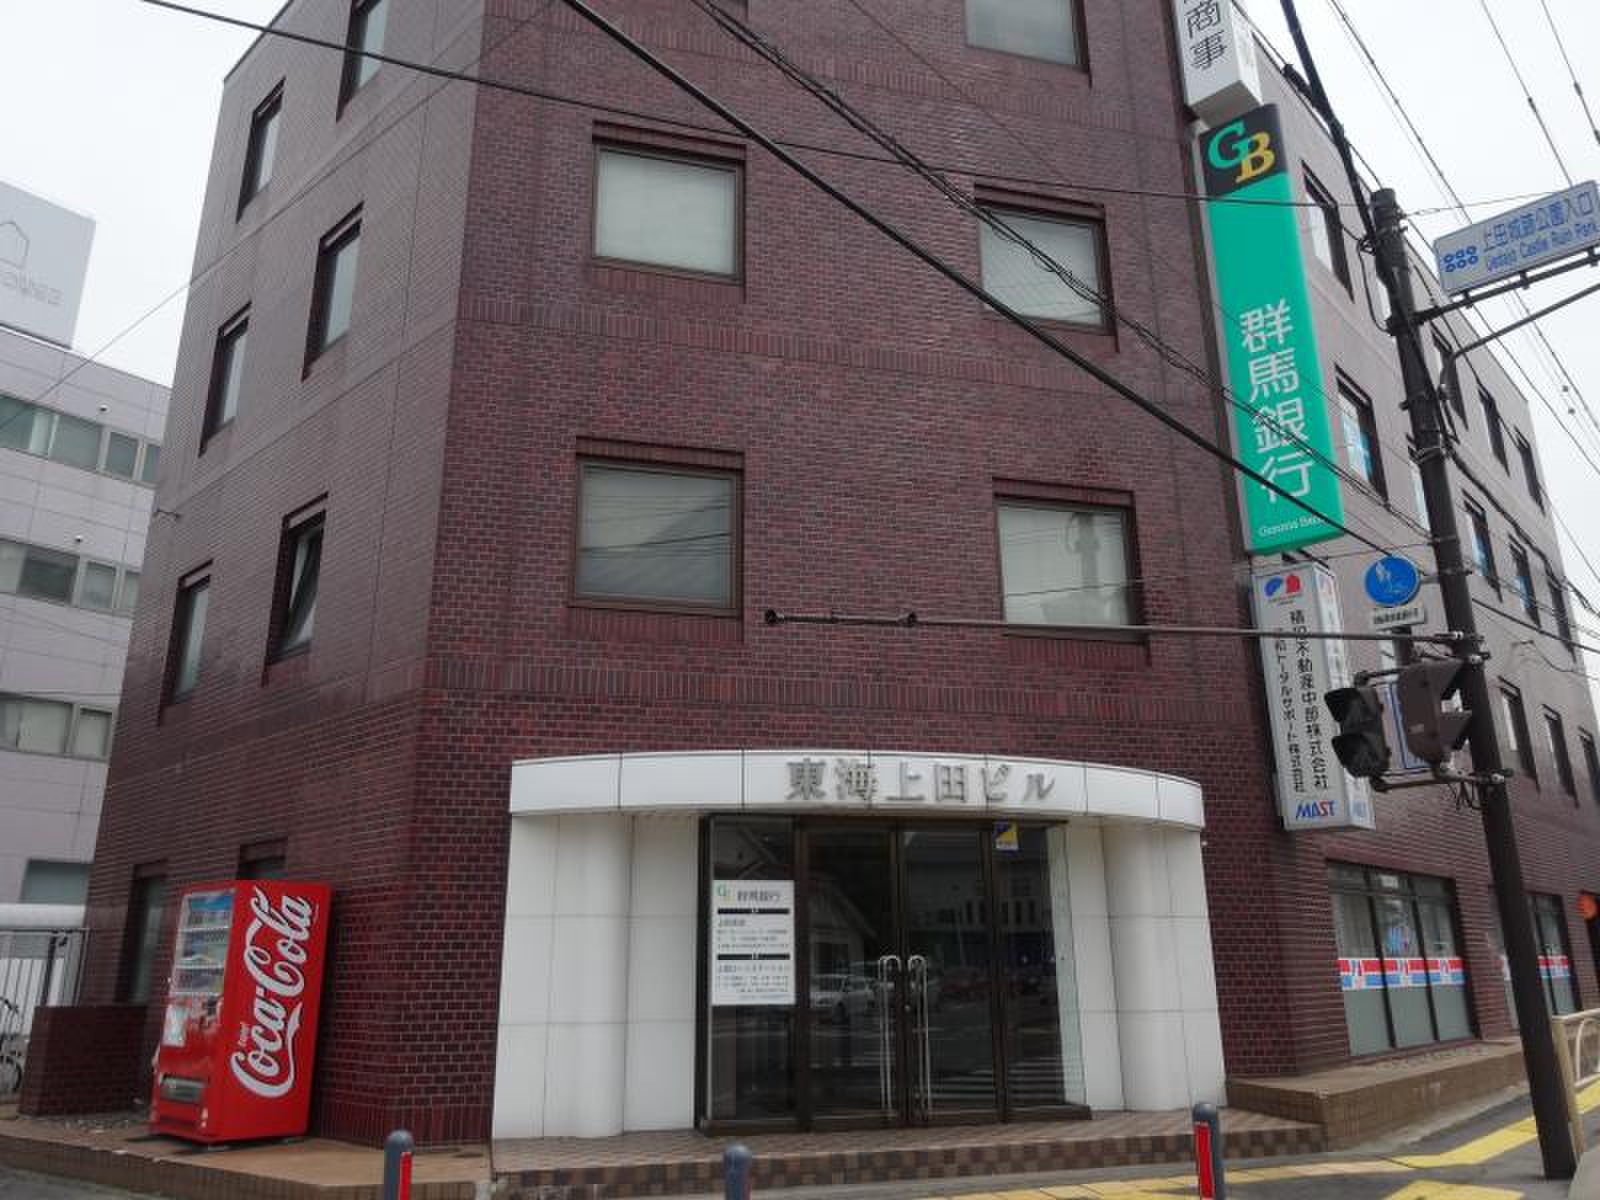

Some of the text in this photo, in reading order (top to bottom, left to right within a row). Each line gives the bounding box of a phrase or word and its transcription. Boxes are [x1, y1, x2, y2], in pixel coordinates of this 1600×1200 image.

[1206, 119, 1277, 184] GB
[1239, 297, 1315, 504] 群馬銀行
[785, 757, 1057, 803] 東海上田ビル
[1295, 800, 1337, 818] MAST
